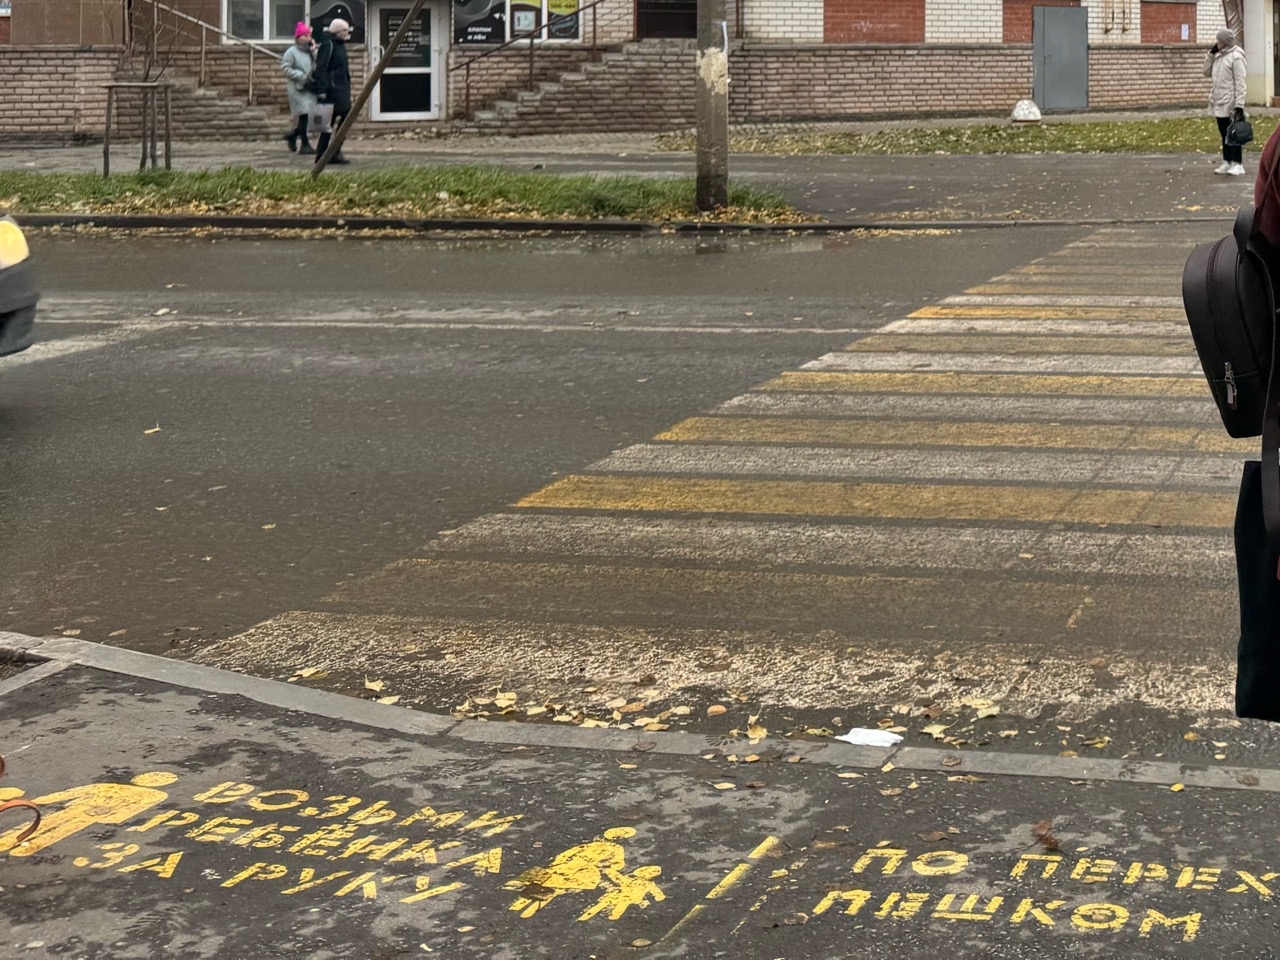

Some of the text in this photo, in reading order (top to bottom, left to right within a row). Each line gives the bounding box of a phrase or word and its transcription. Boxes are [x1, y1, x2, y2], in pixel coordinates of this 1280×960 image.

[193, 781, 524, 837] ВОЗЬМИ
[73, 842, 184, 879] ЗА
[852, 847, 969, 877] ПО
[220, 862, 467, 905] РУКУ
[811, 888, 1203, 941] ПЕШКОМ
